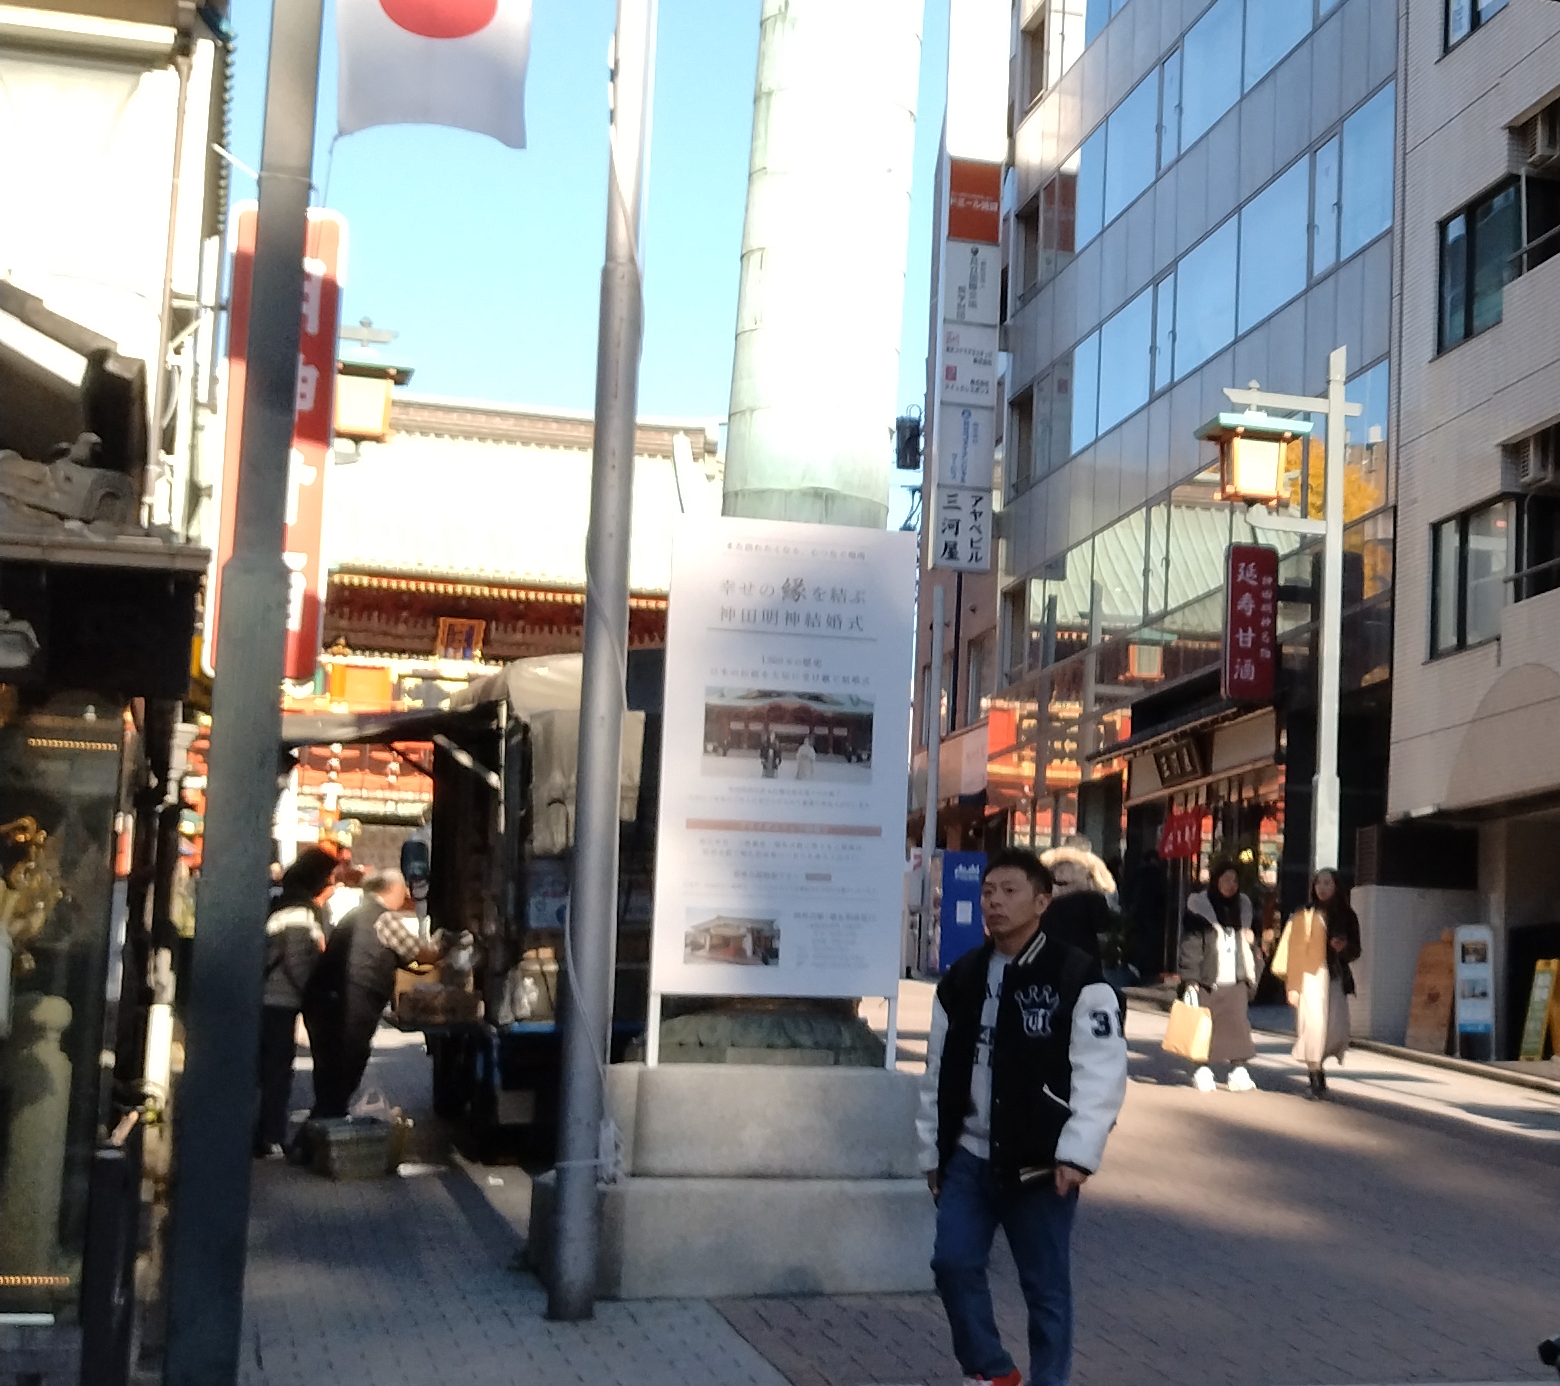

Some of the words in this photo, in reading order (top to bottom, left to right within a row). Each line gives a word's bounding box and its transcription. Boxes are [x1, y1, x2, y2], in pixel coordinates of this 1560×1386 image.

[941, 494, 962, 561] 三河屋
[968, 495, 983, 564] アヤベビル
[720, 606, 864, 632] 神田明神結婚式
[722, 577, 866, 604] 幸せの縁を結ぶ
[1233, 562, 1258, 681] 延寿甘酒
